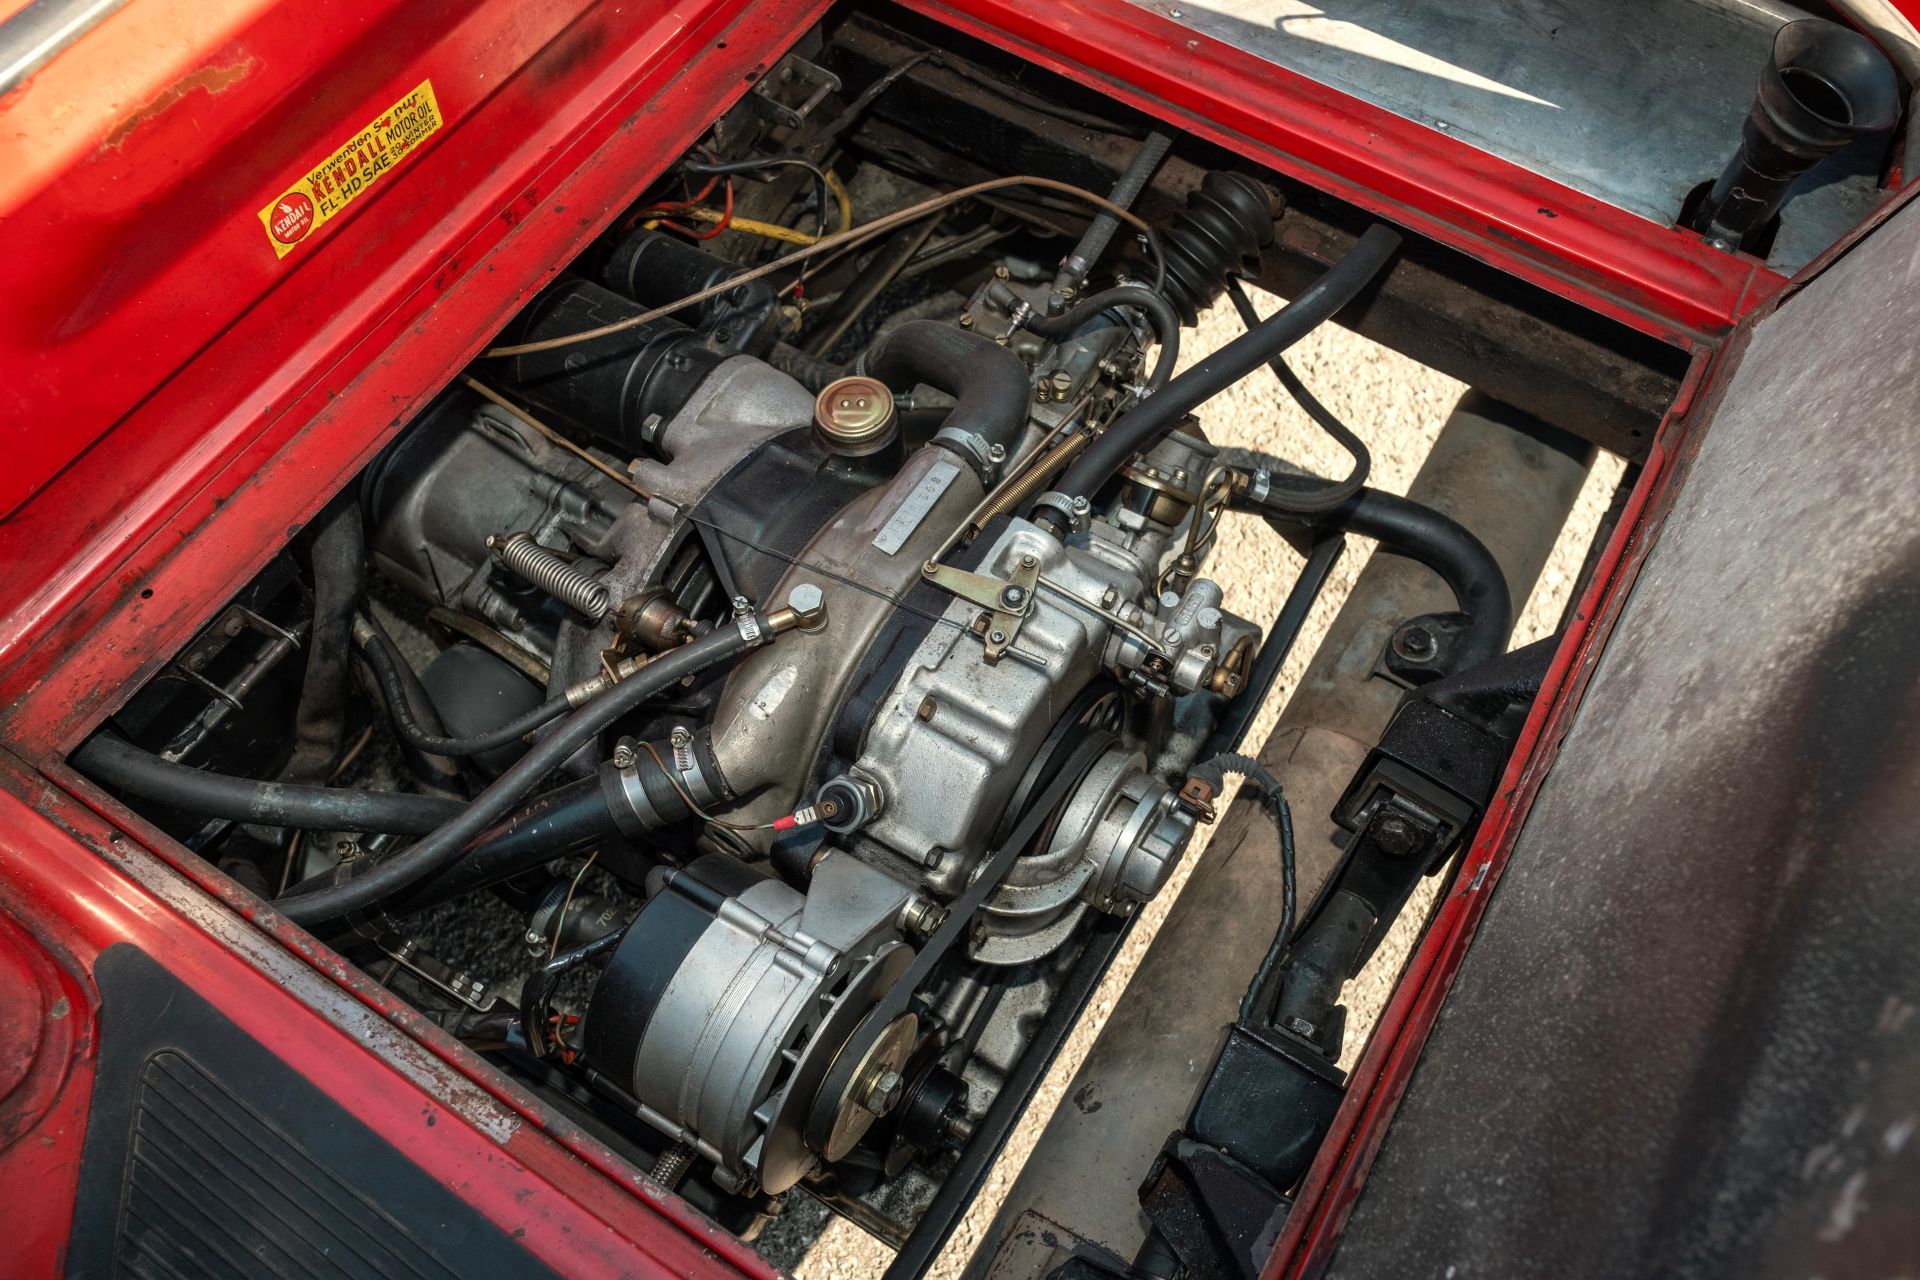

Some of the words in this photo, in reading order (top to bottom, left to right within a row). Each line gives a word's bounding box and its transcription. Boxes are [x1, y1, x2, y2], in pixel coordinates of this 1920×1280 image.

[405, 120, 437, 148] OMMER
[306, 132, 371, 184] Verwenden
[311, 135, 386, 203] KENDALL
[385, 111, 418, 144] MOTOR
[417, 101, 432, 119] OIL
[363, 152, 391, 182] SAE
[274, 201, 311, 235] KENDALL
